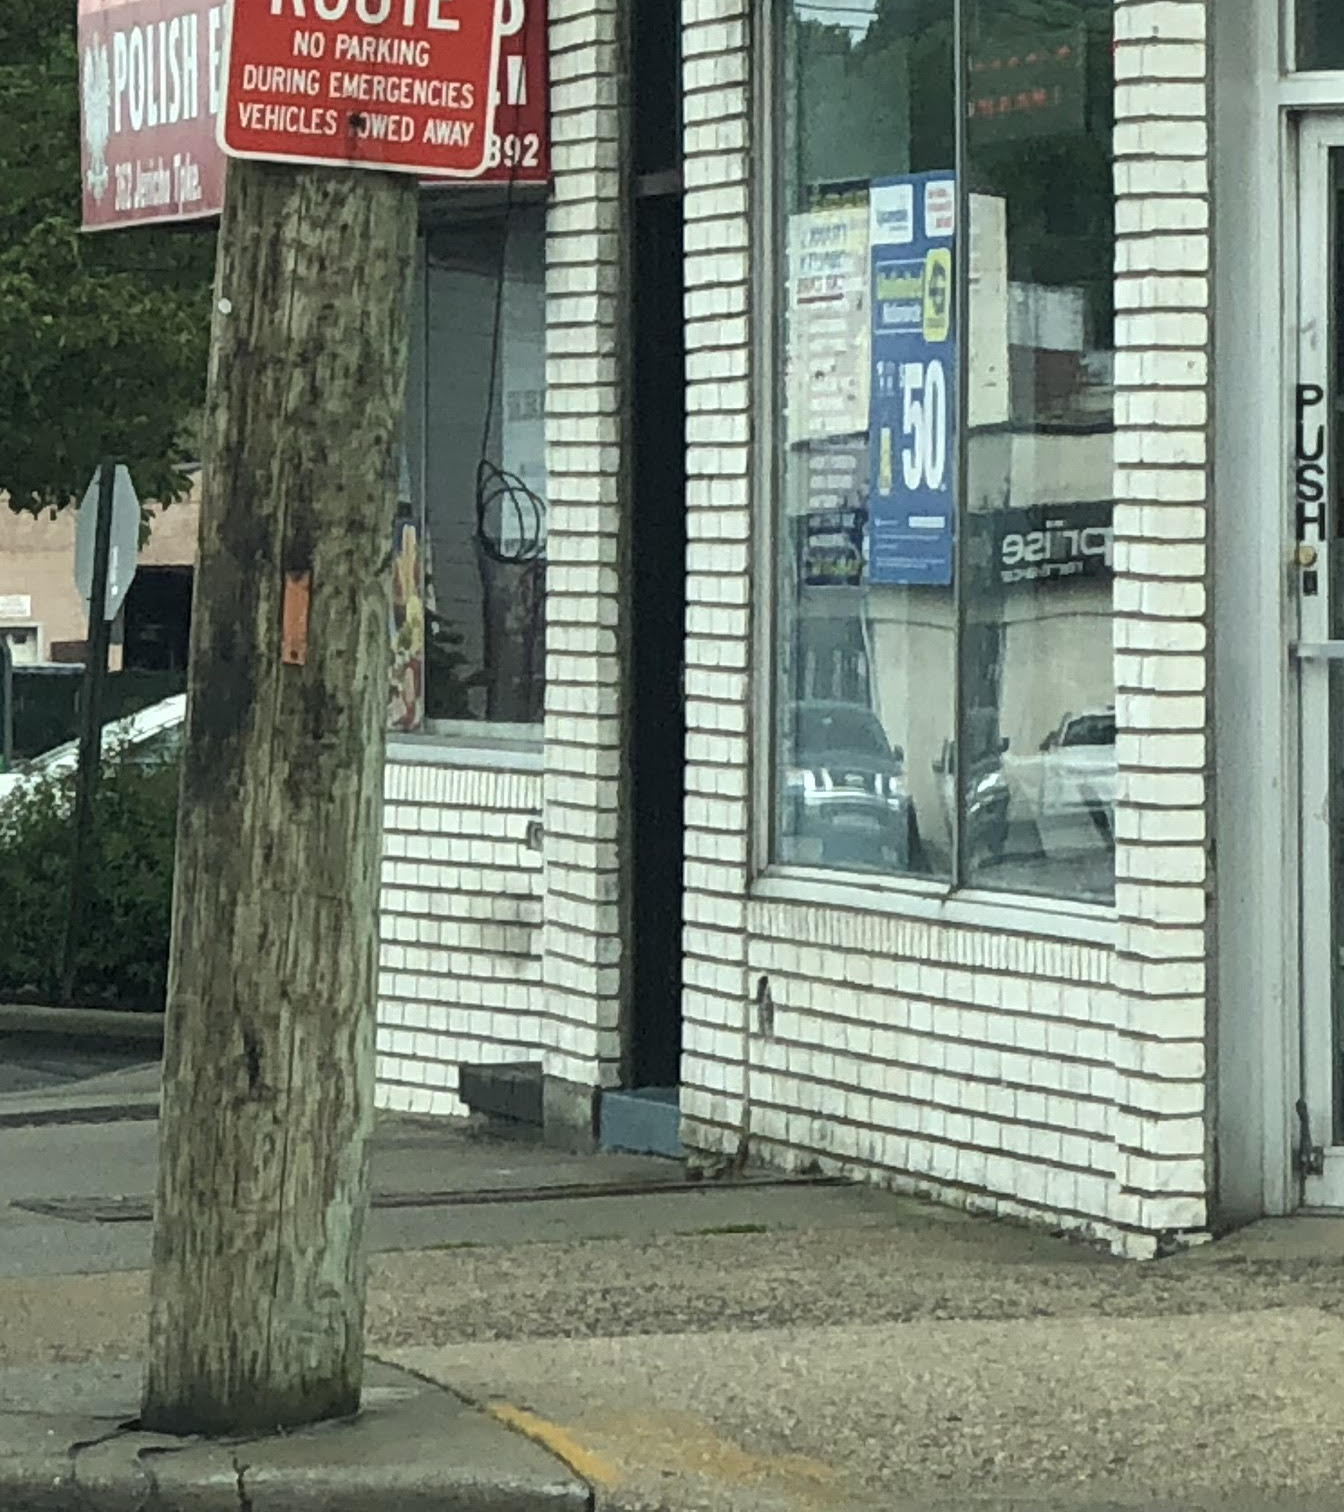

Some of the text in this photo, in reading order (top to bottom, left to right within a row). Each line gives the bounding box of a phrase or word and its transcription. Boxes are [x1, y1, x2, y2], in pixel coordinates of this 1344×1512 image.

[293, 30, 431, 68] NO PARKING
[113, 13, 198, 133] POLISH
[243, 64, 321, 96] DURING
[328, 71, 475, 110] EMERGENCIES
[238, 102, 475, 147] VEHICLES OWED AWAY
[1295, 384, 1326, 542] PUSH
